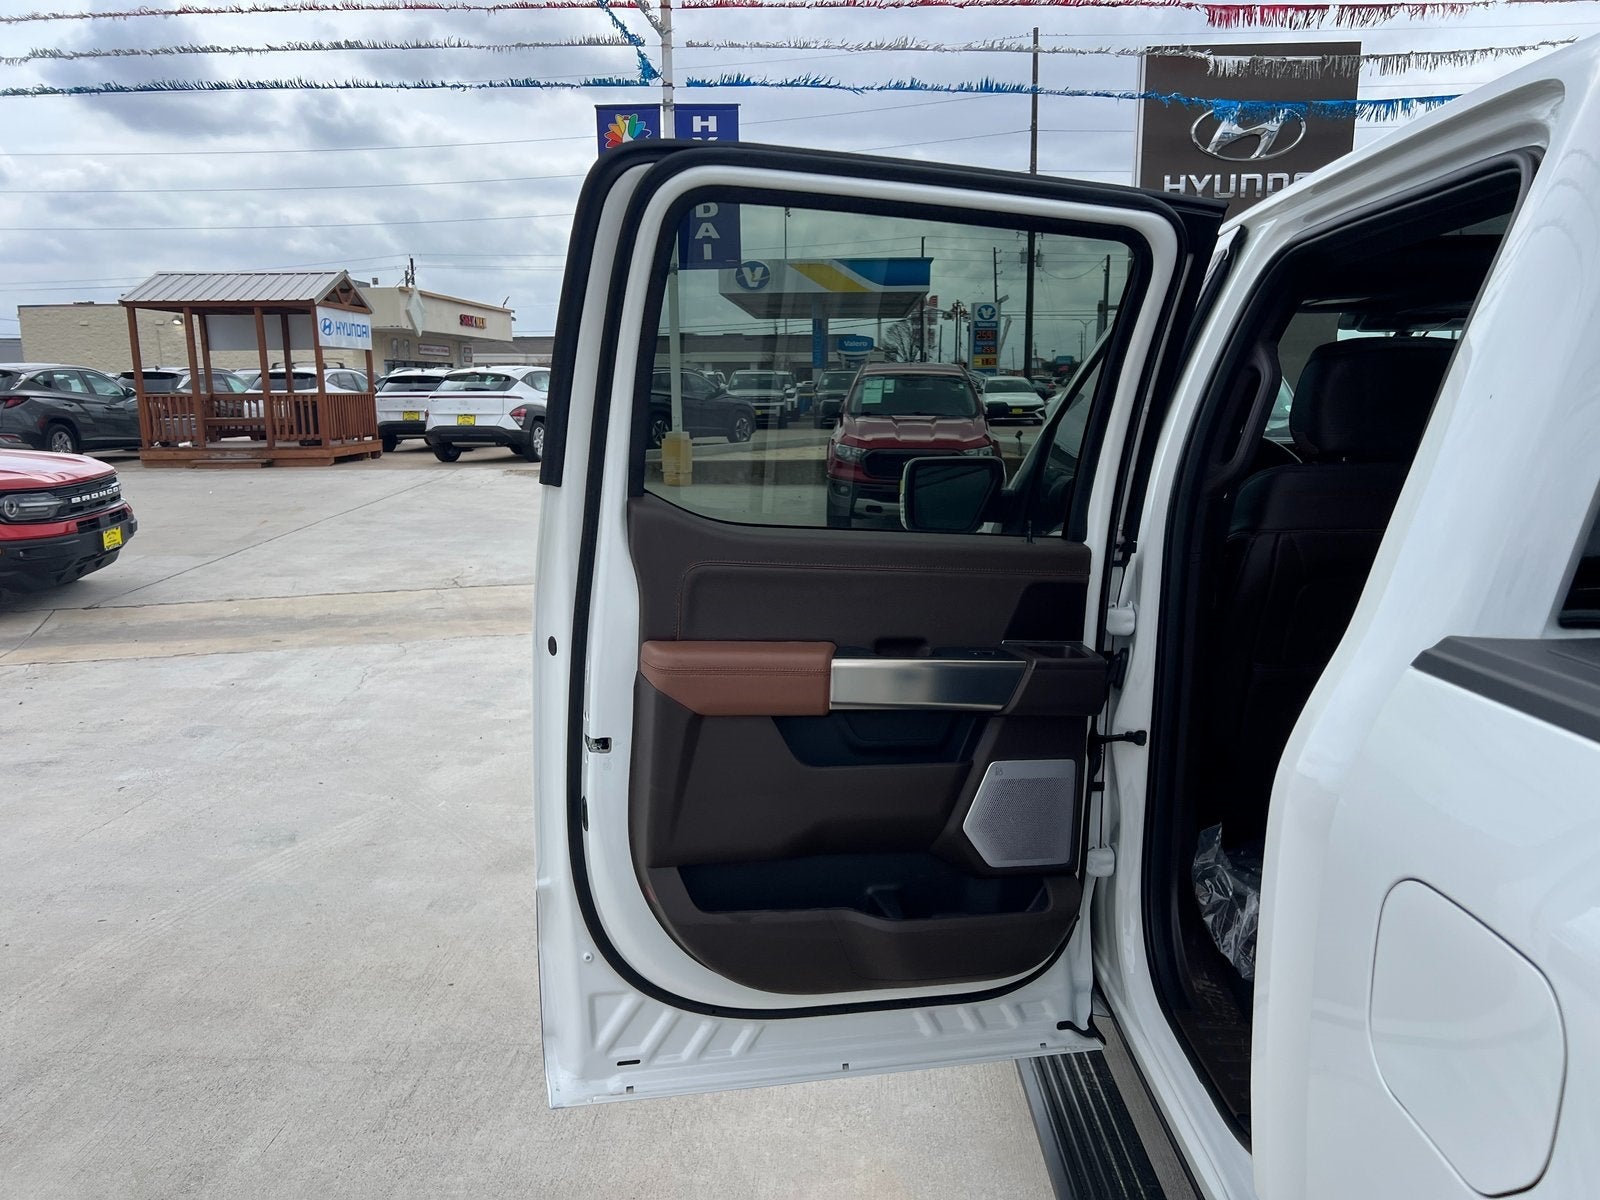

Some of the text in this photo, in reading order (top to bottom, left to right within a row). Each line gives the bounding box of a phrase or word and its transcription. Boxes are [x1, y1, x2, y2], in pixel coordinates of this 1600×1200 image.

[1163, 172, 1312, 199] HYUND
[335, 320, 370, 339] HYUNDAI
[71, 486, 120, 504] BRONCO
